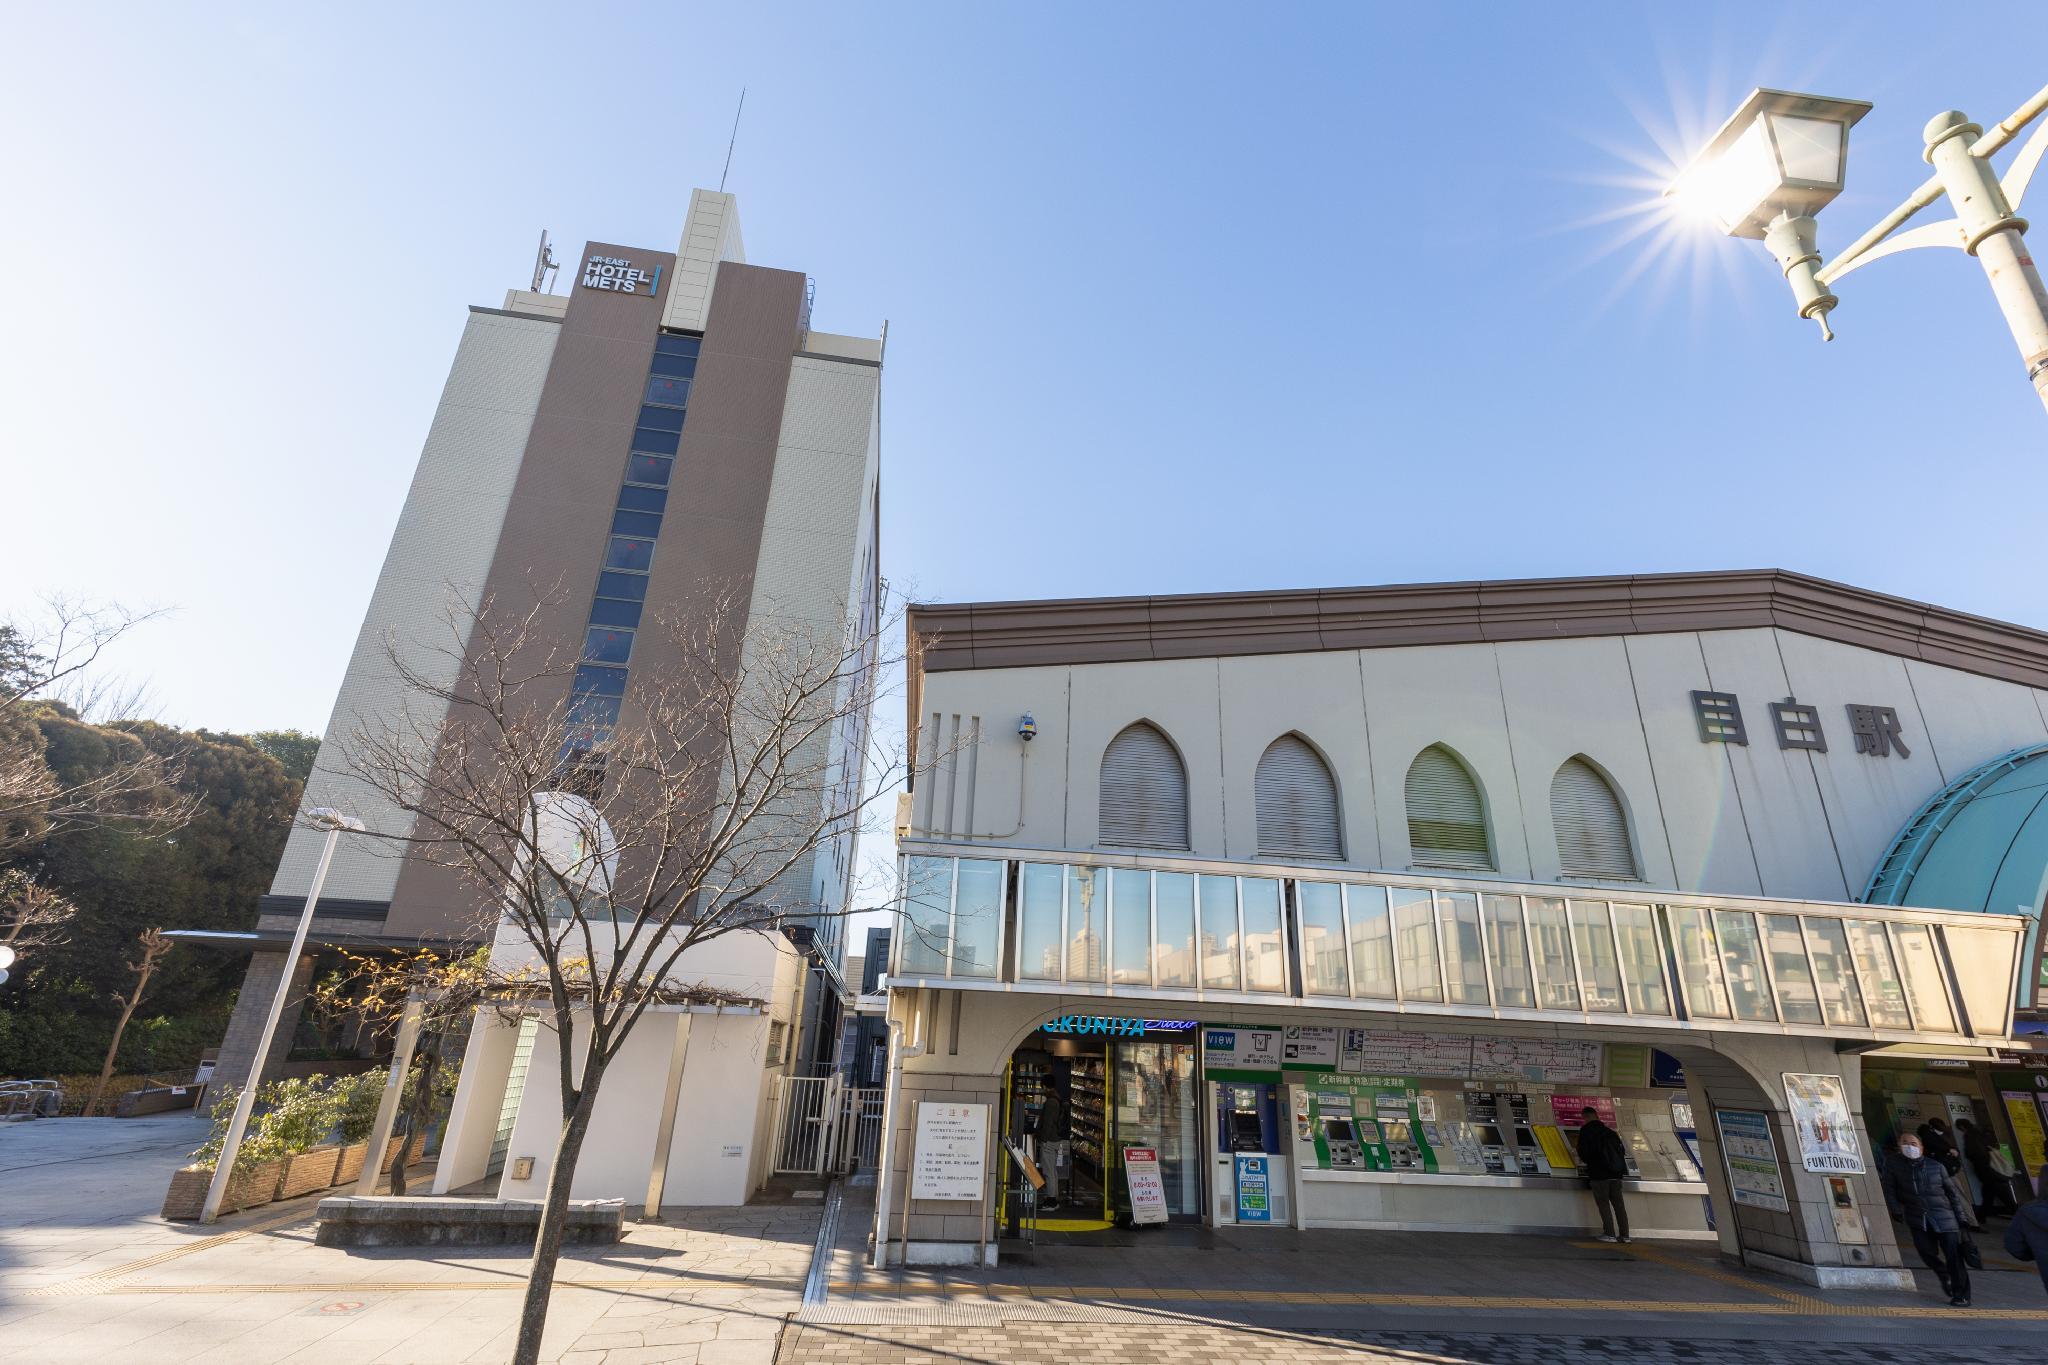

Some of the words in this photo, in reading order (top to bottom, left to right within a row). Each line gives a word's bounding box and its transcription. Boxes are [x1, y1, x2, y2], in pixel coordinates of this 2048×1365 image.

[589, 256, 631, 267] JR-EAST
[585, 262, 650, 283] HOTEL
[582, 274, 636, 293] METS
[1689, 689, 1911, 760] 目白駅
[1208, 1034, 1234, 1045] view
